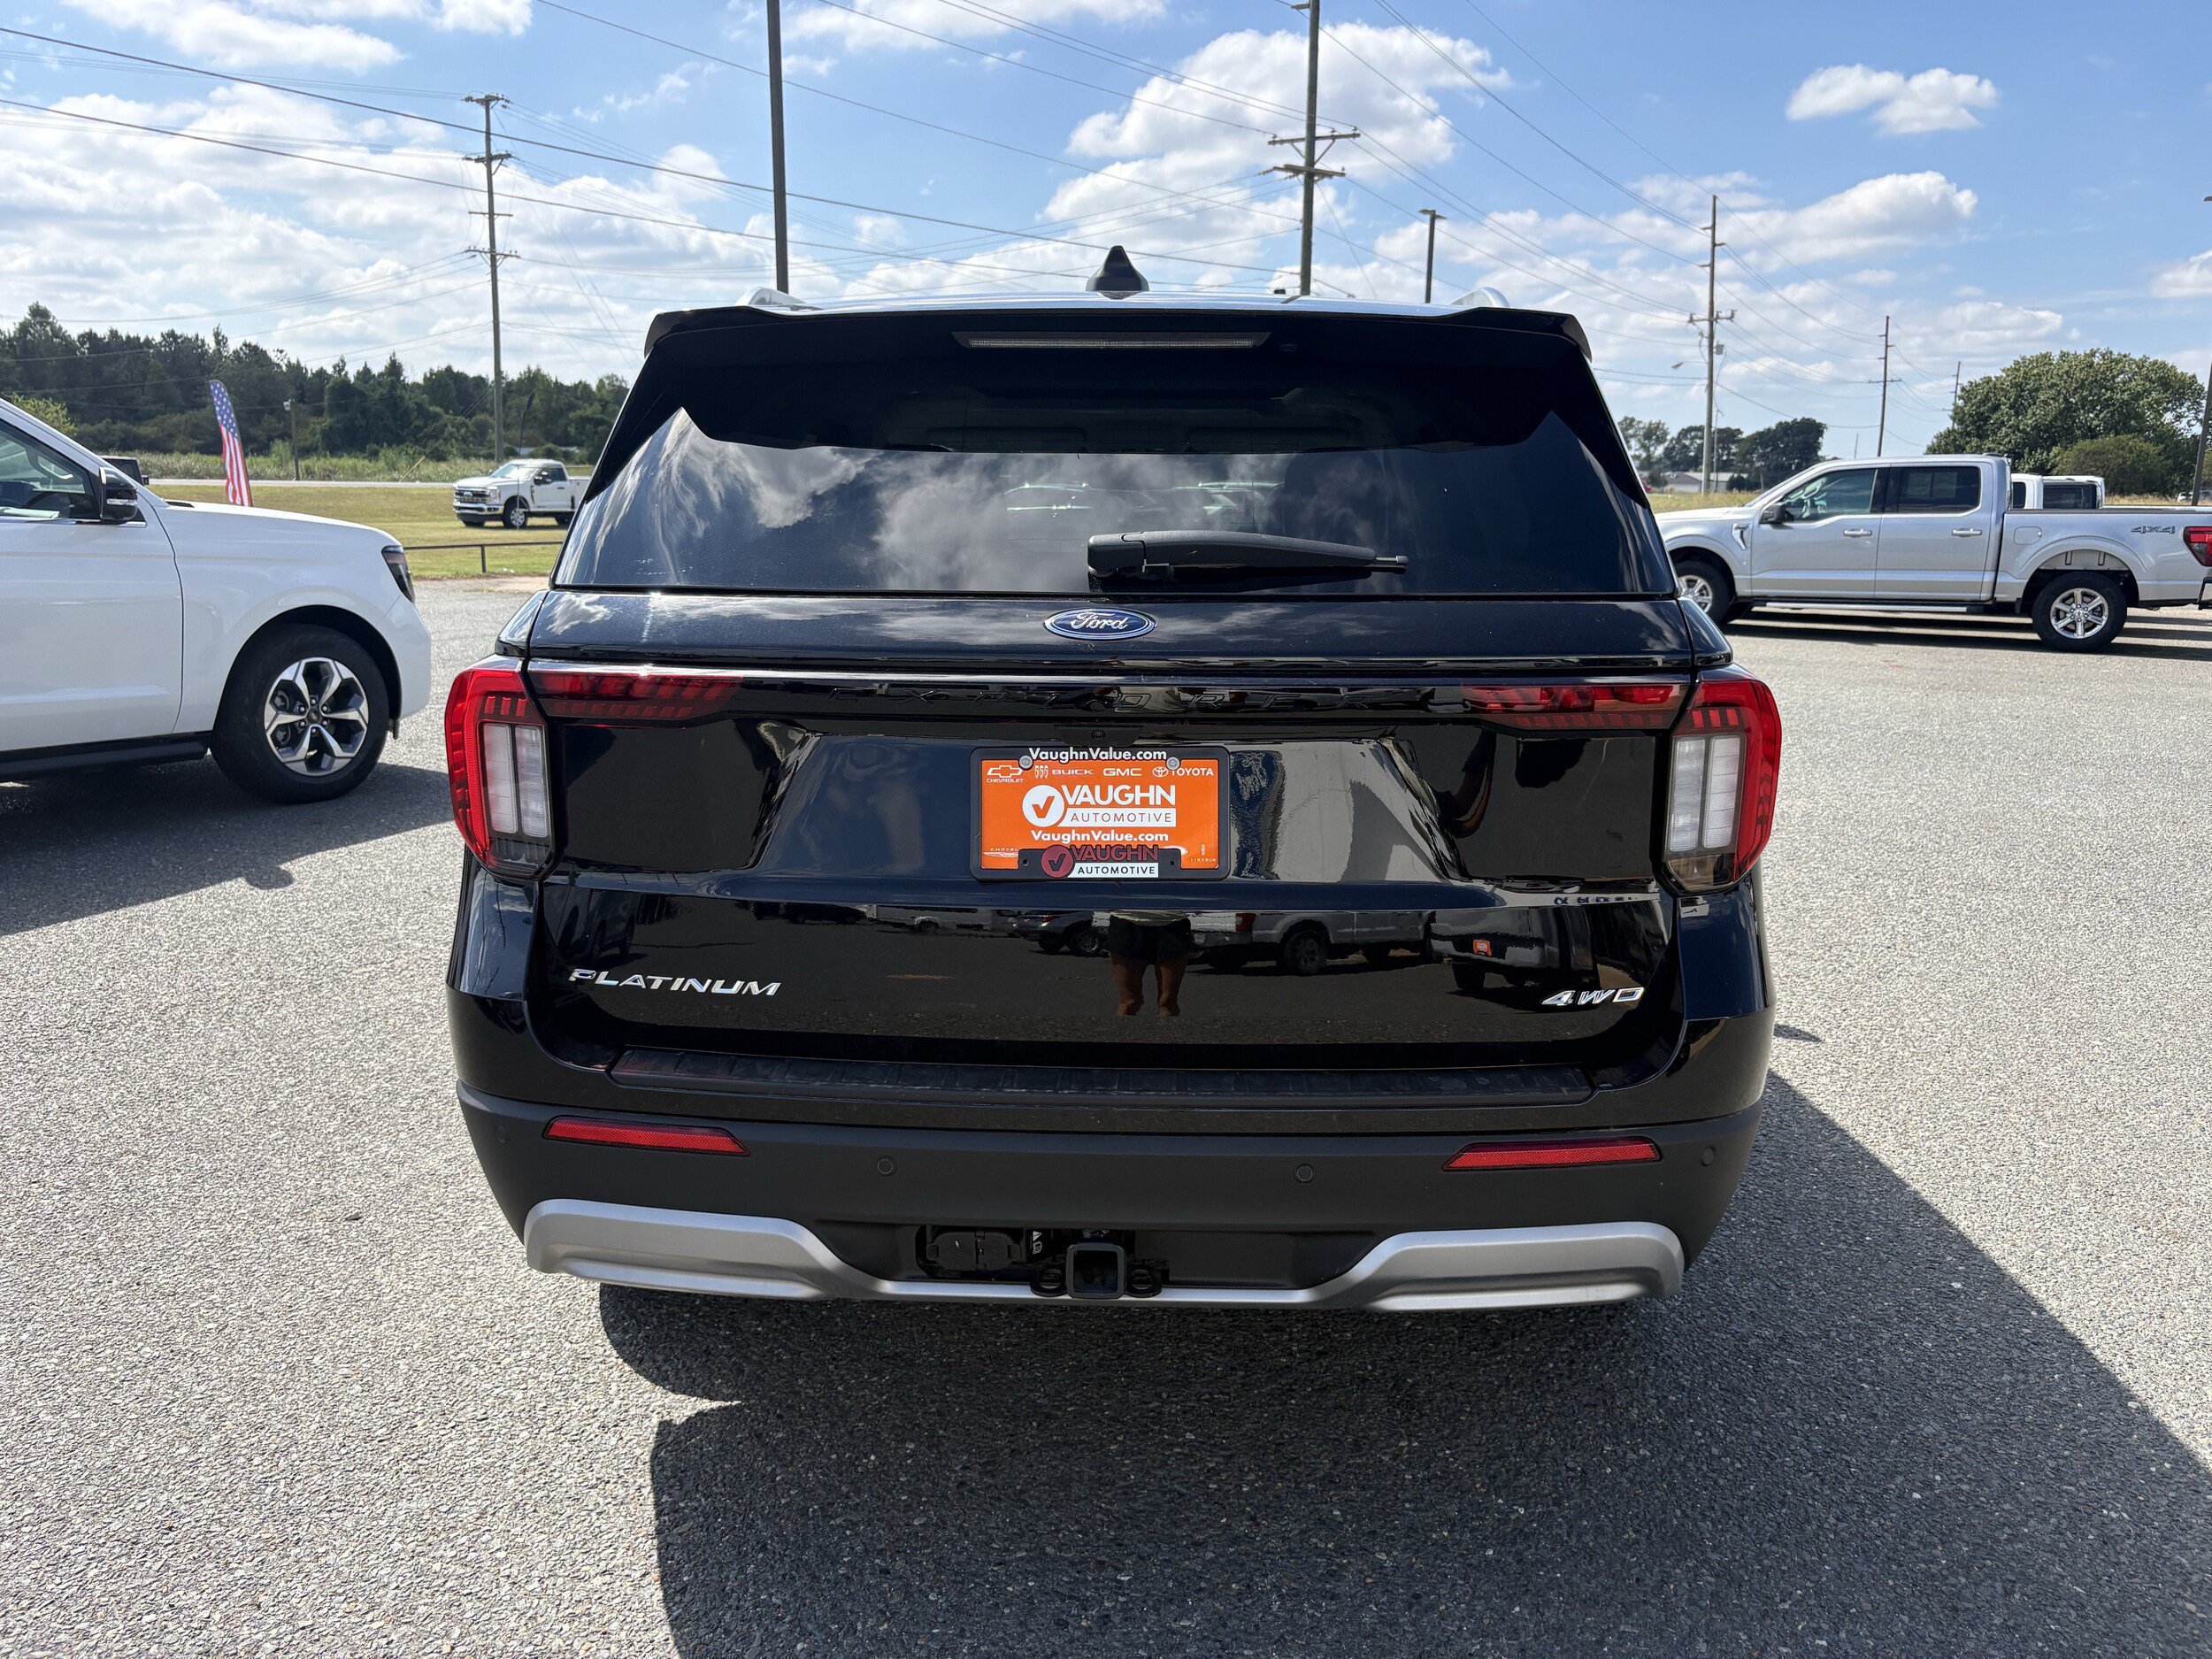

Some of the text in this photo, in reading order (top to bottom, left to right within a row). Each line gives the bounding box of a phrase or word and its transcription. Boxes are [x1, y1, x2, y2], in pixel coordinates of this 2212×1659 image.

[1070, 611, 1128, 630] Ford
[1029, 747, 1167, 763] VaughnValue.com
[1102, 767, 1142, 777] GMC
[1061, 785, 1176, 805] VAUGHN
[1071, 812, 1171, 823] AUTOMOTIVE
[1031, 830, 1169, 843] VaughnValue.com
[1070, 844, 1159, 862] VAUGHN
[1077, 865, 1156, 875] AUTOMOTIVE
[569, 969, 781, 995] PLATINUM
[1542, 987, 1645, 1006] 4WD
